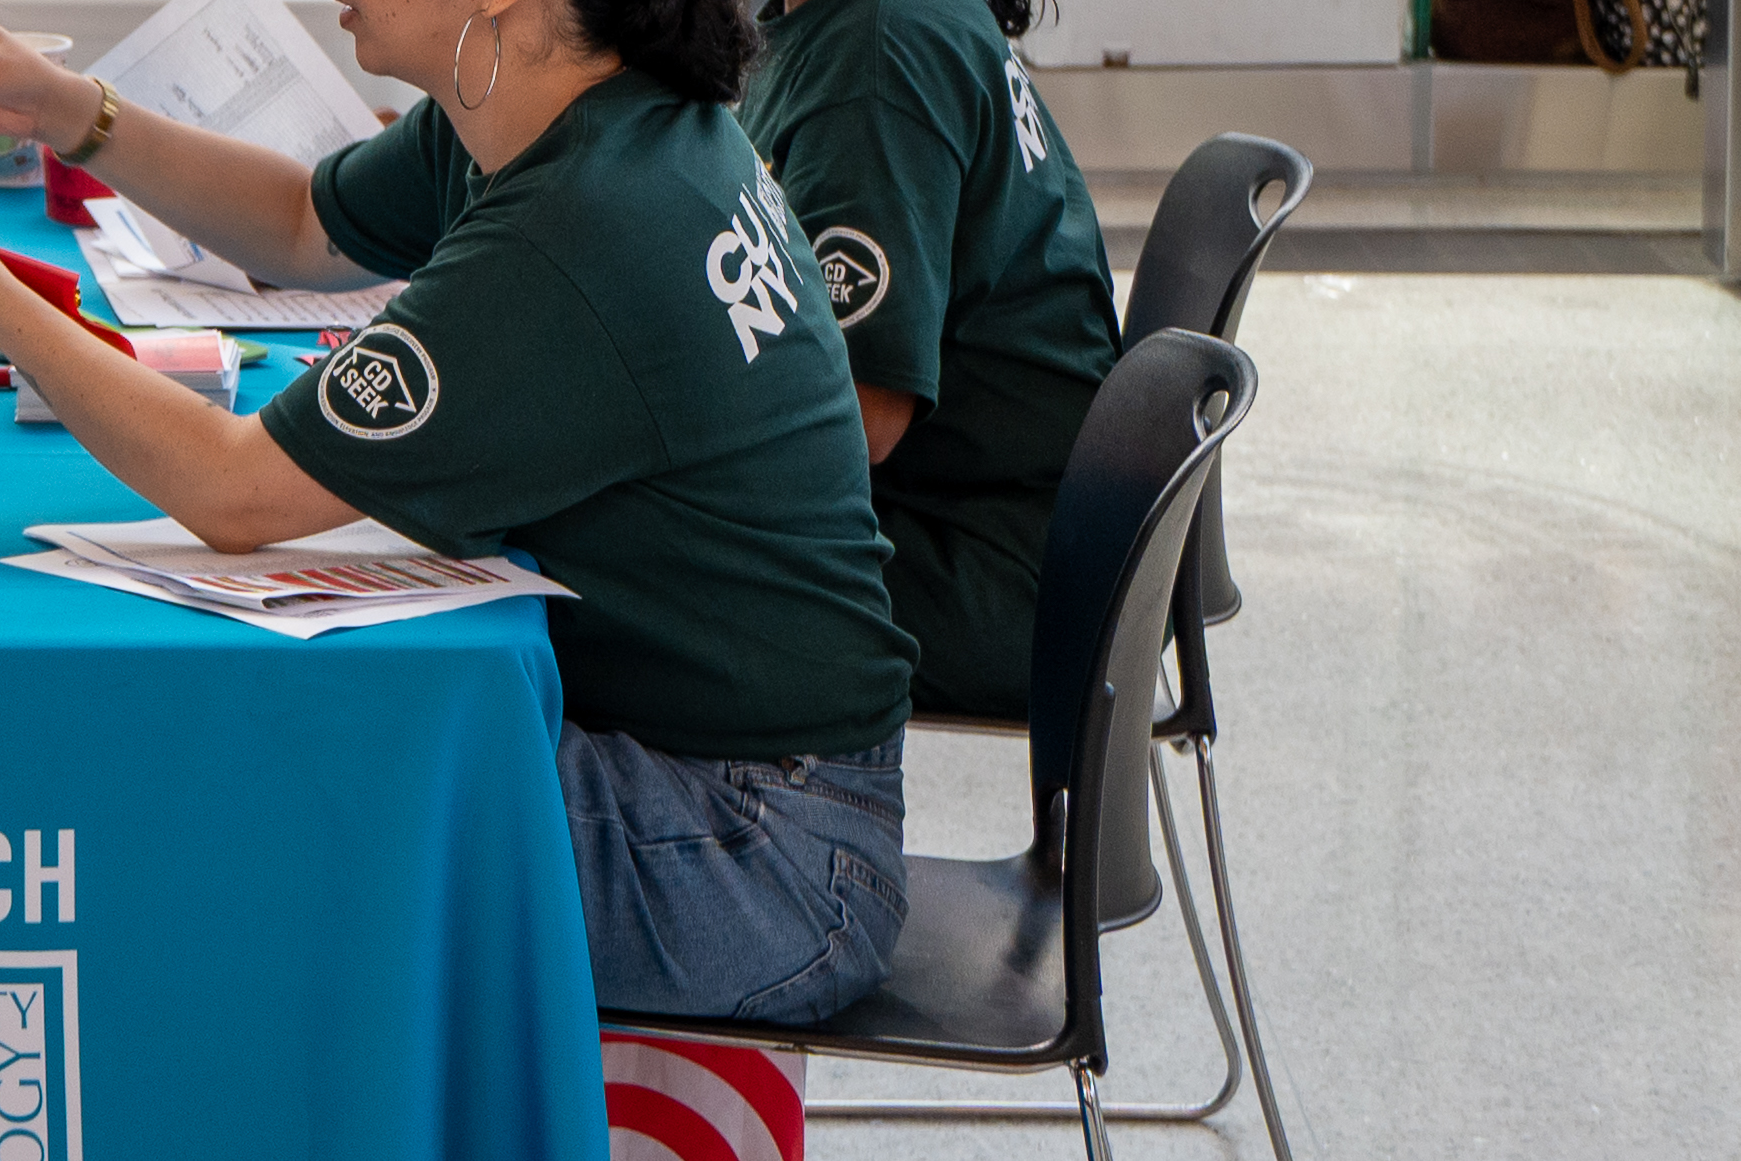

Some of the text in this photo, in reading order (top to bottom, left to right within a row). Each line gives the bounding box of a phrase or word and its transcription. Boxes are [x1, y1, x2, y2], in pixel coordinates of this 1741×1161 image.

[706, 192, 769, 304] CU
[825, 263, 846, 282] CD
[826, 283, 854, 304] EK
[727, 242, 798, 364] NY
[339, 368, 389, 420] SEEK
[363, 360, 393, 392] CD
